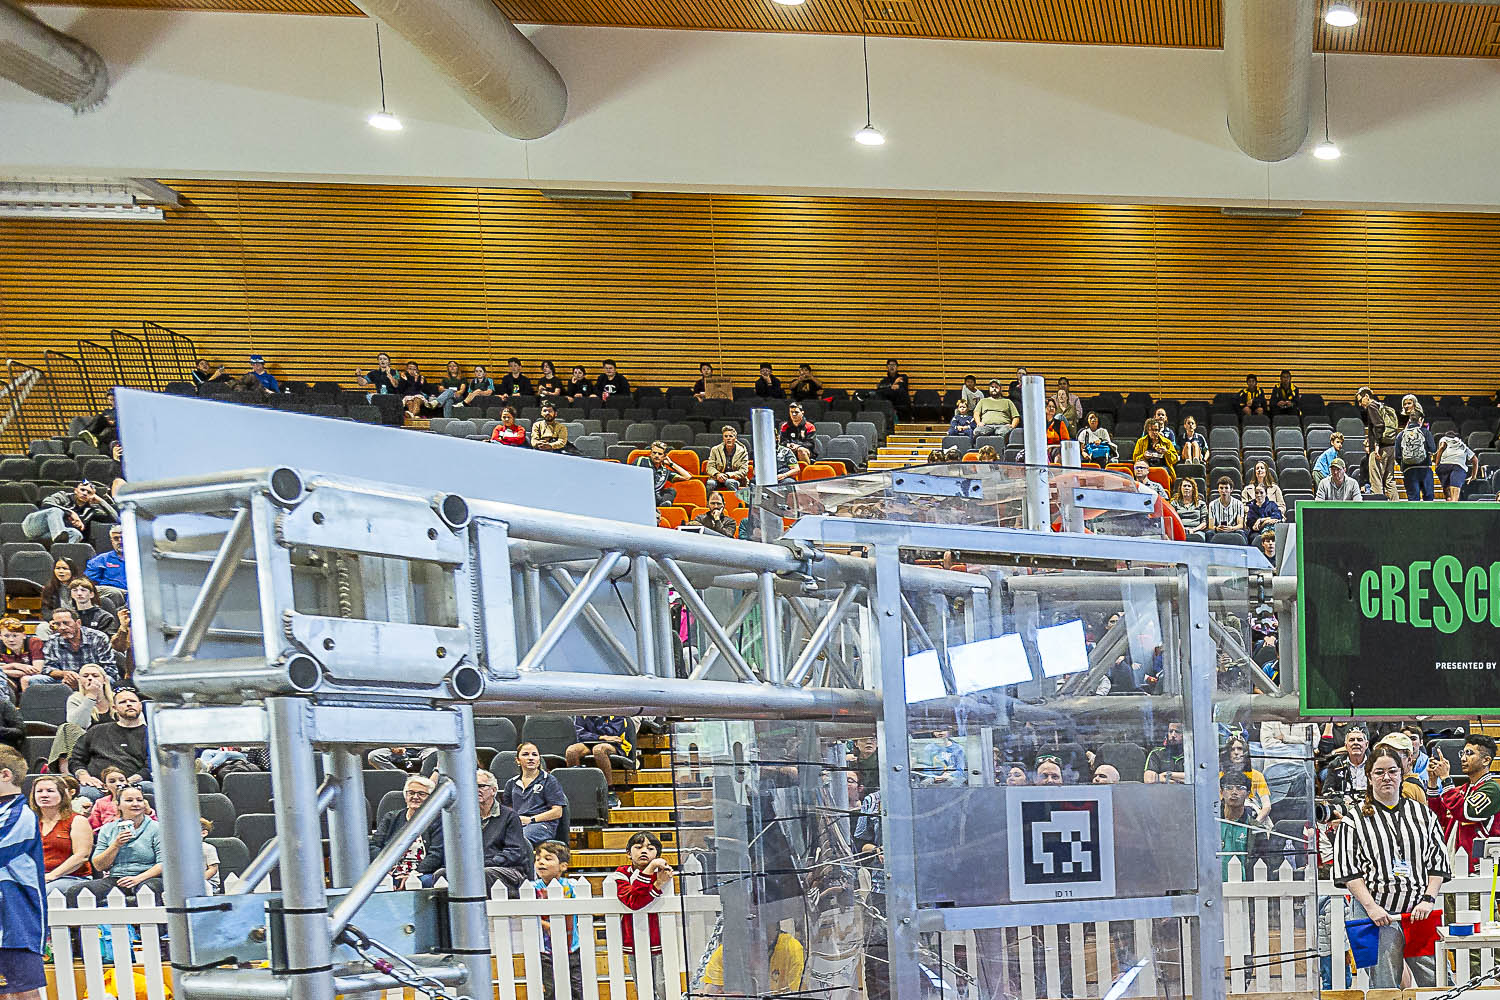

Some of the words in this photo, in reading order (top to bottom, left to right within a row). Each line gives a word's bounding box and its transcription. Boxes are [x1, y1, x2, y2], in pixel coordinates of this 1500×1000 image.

[1435, 662, 1483, 670] PRESENTED
[1486, 662, 1497, 670] BY
[1055, 890, 1063, 898] ID
